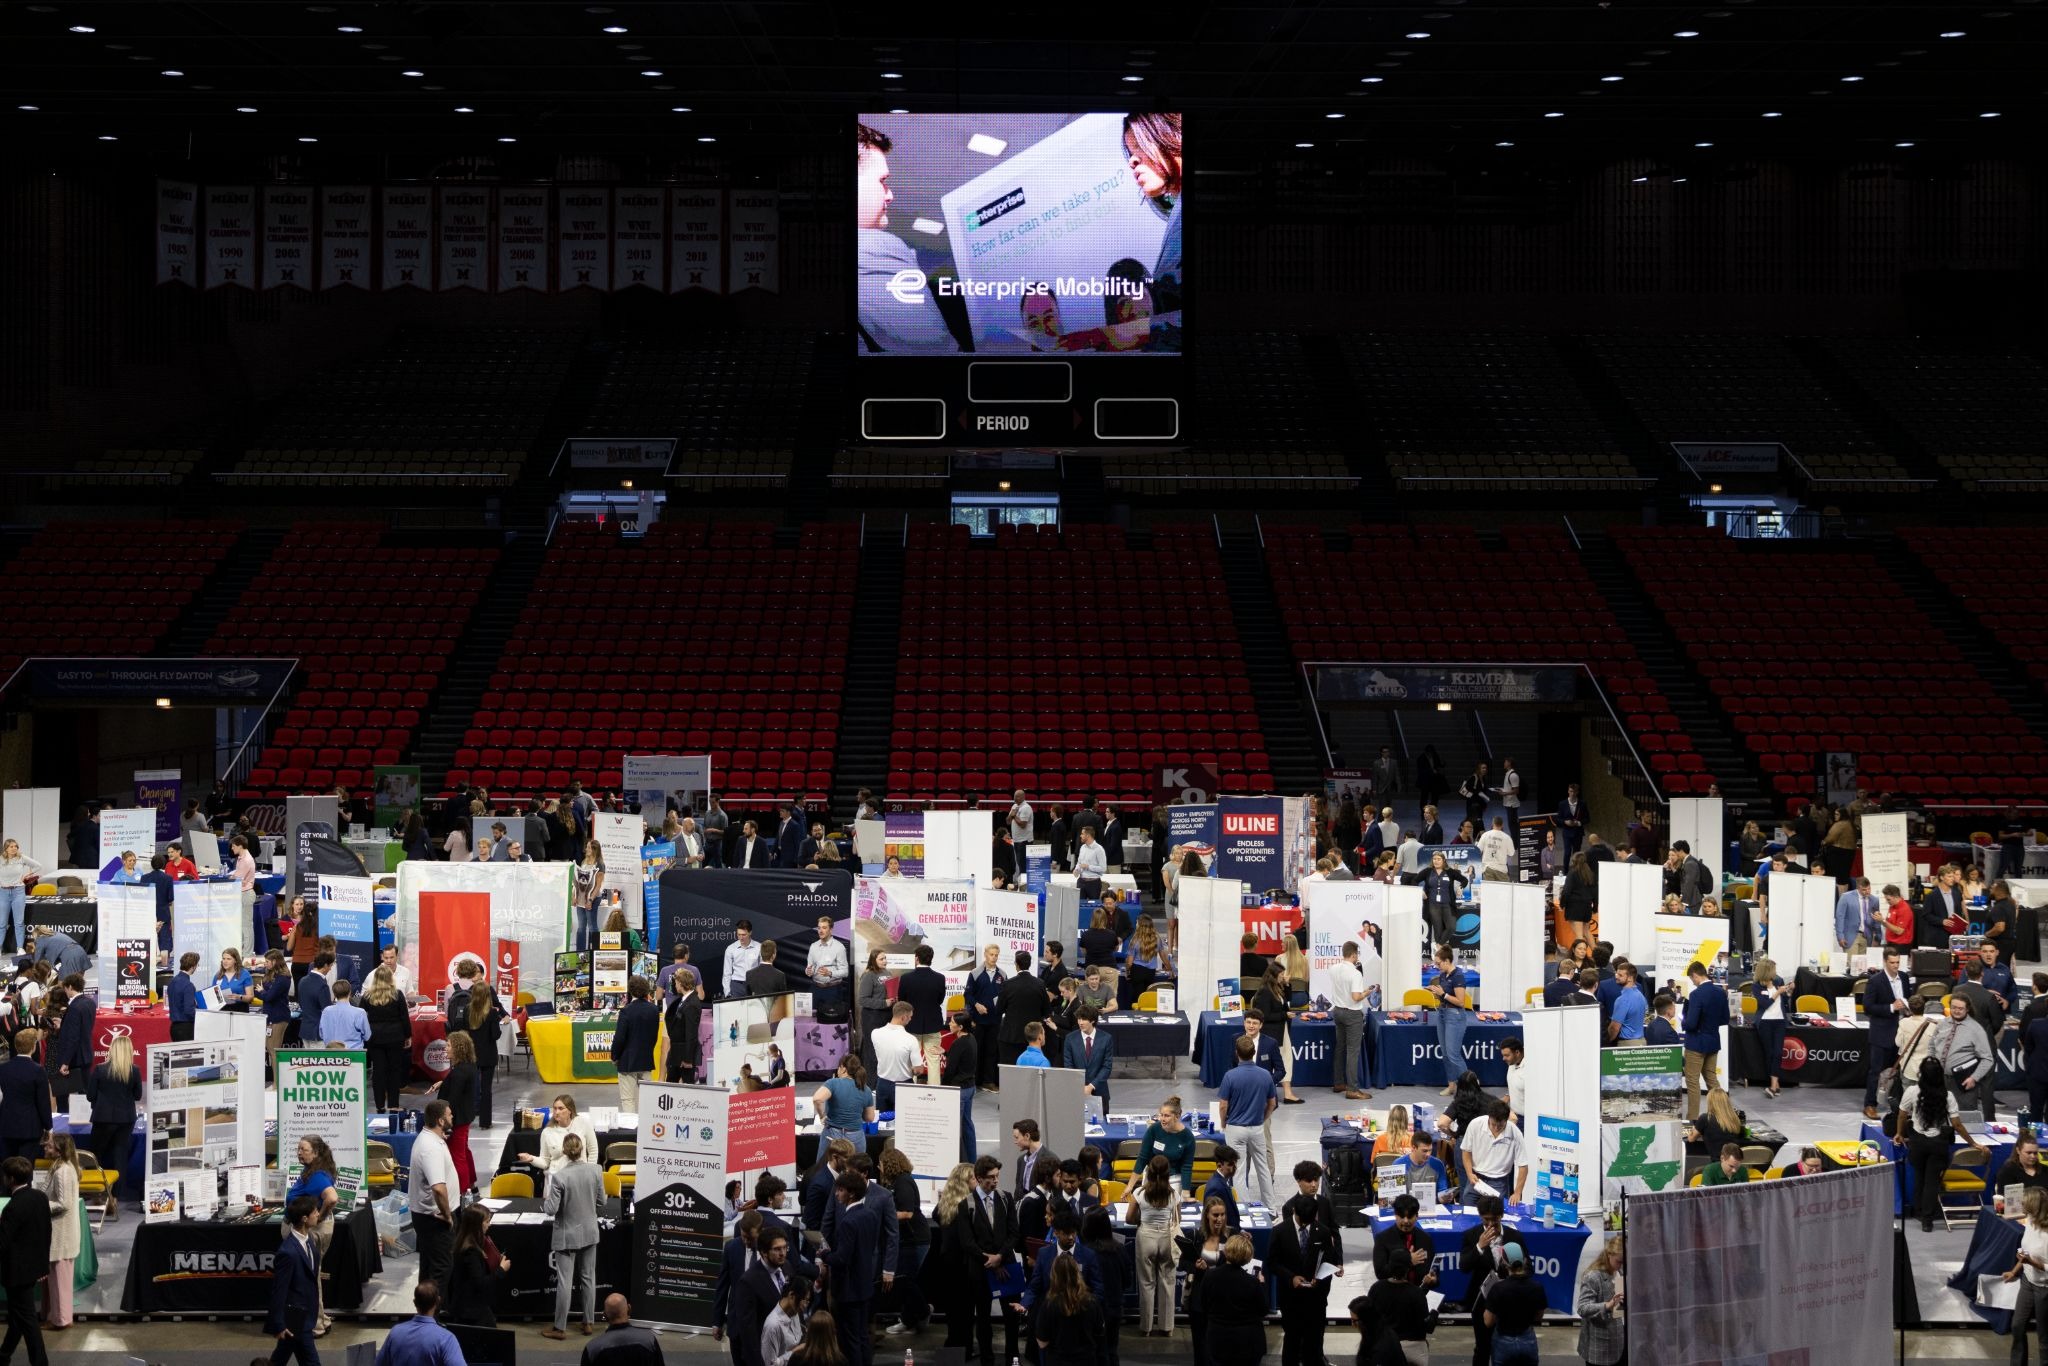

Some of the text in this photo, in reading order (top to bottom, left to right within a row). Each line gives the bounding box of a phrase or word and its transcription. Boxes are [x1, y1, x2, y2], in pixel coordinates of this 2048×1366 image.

[972, 171, 1126, 257] How far can we take you?
[938, 277, 1049, 300] Enterprise
[977, 416, 1029, 430] PERIOD
[57, 672, 79, 681] EASY
[80, 672, 93, 681] TO
[158, 672, 175, 681] FLY
[176, 672, 213, 681] DAYTON
[1451, 673, 1516, 686] KEMBA
[1163, 769, 1190, 787] K
[432, 803, 443, 811] 21
[807, 804, 818, 812] 21
[892, 804, 902, 812] 20
[1731, 807, 1742, 815] 19
[1227, 817, 1275, 832] ULINE
[300, 832, 312, 840] GET
[1227, 847, 1275, 855] OPPORTUNITIES
[334, 886, 364, 896] Reynolds
[788, 895, 838, 903] PHAIDON
[928, 893, 967, 902] MADE FOR
[1345, 893, 1374, 903] protiviti
[943, 904, 967, 912] A NEW
[674, 916, 732, 929] Reimagine
[919, 914, 967, 924] GENERATION
[986, 916, 1035, 930] THE MATERIAL
[993, 928, 1035, 941] DIFFERENCE
[1240, 921, 1292, 941] LINE
[674, 930, 737, 943] your potent
[1315, 932, 1331, 944] LIVE
[117, 940, 145, 949] we're
[1010, 941, 1035, 951] IS YOU
[94, 1050, 111, 1058] RUSH
[1412, 1040, 1495, 1067] proviti
[1808, 1049, 1860, 1062] source
[291, 1057, 352, 1066] MENARDS
[297, 1071, 346, 1086] NOW
[283, 1088, 360, 1103] HIRING
[759, 1096, 786, 1105] experience
[328, 1103, 347, 1111] YOU
[755, 1104, 774, 1113] patient
[302, 1111, 315, 1119] join
[330, 1110, 350, 1118] team!
[732, 1115, 756, 1124] caregiver
[682, 1117, 714, 1125] COMPANIES
[744, 1121, 772, 1131] everything
[1558, 1126, 1575, 1136] Hiring
[643, 1156, 721, 1171] SALES & RECRUITING
[744, 1154, 768, 1165] midmark
[657, 1165, 705, 1181] Opportunities
[664, 1192, 696, 1208] 30+
[650, 1208, 710, 1220] OFFICES NATIONWIDE
[174, 1252, 277, 1271] MENAR
